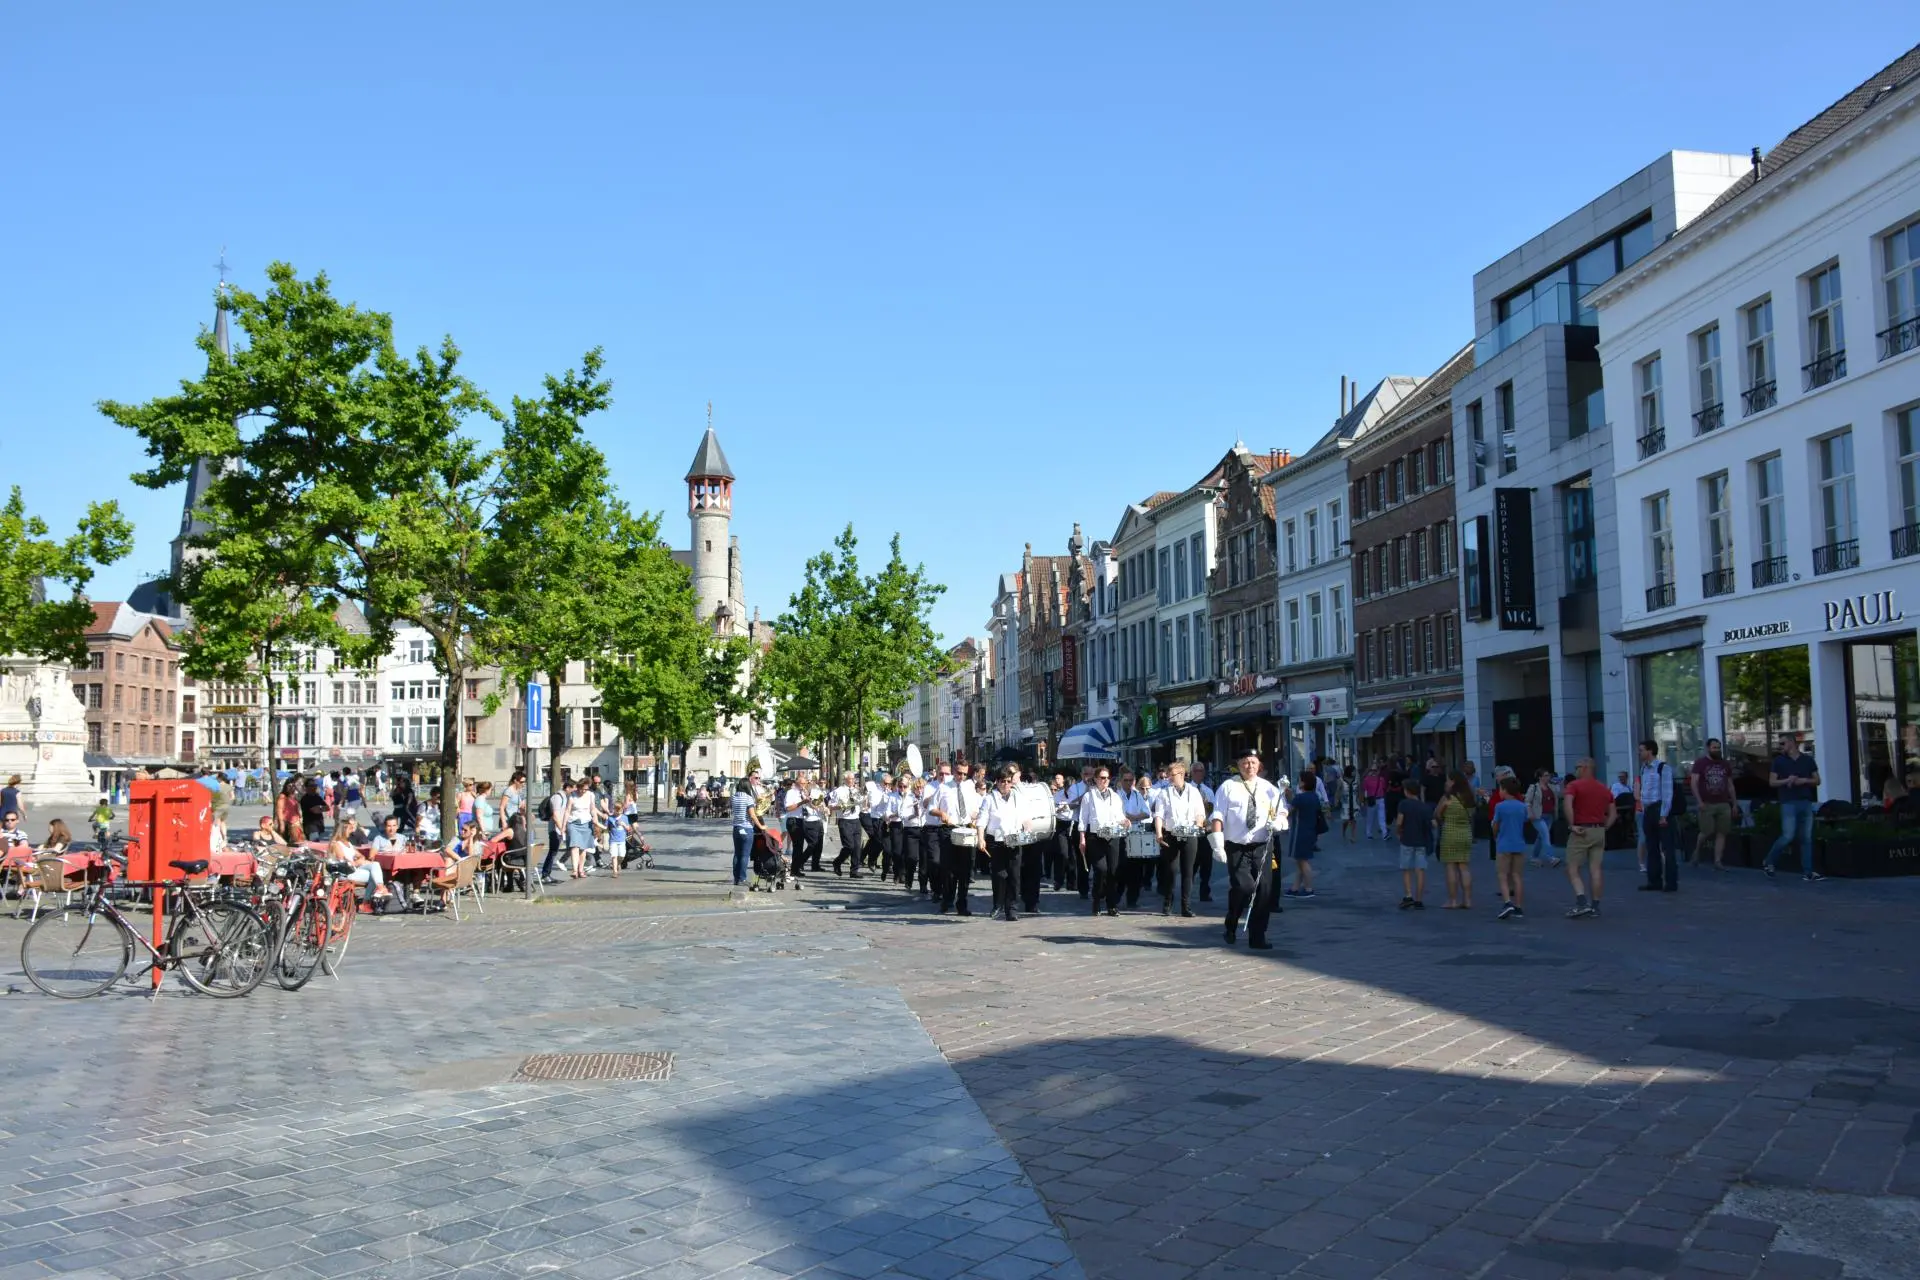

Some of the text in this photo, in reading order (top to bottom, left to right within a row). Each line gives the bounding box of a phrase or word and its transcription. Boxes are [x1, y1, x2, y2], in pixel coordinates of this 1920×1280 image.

[1500, 494, 1511, 603] SHOPPING CENTER
[1824, 590, 1904, 632] PAUL
[1724, 621, 1791, 642] BOULANGERIE
[1888, 847, 1918, 858] PAUL
